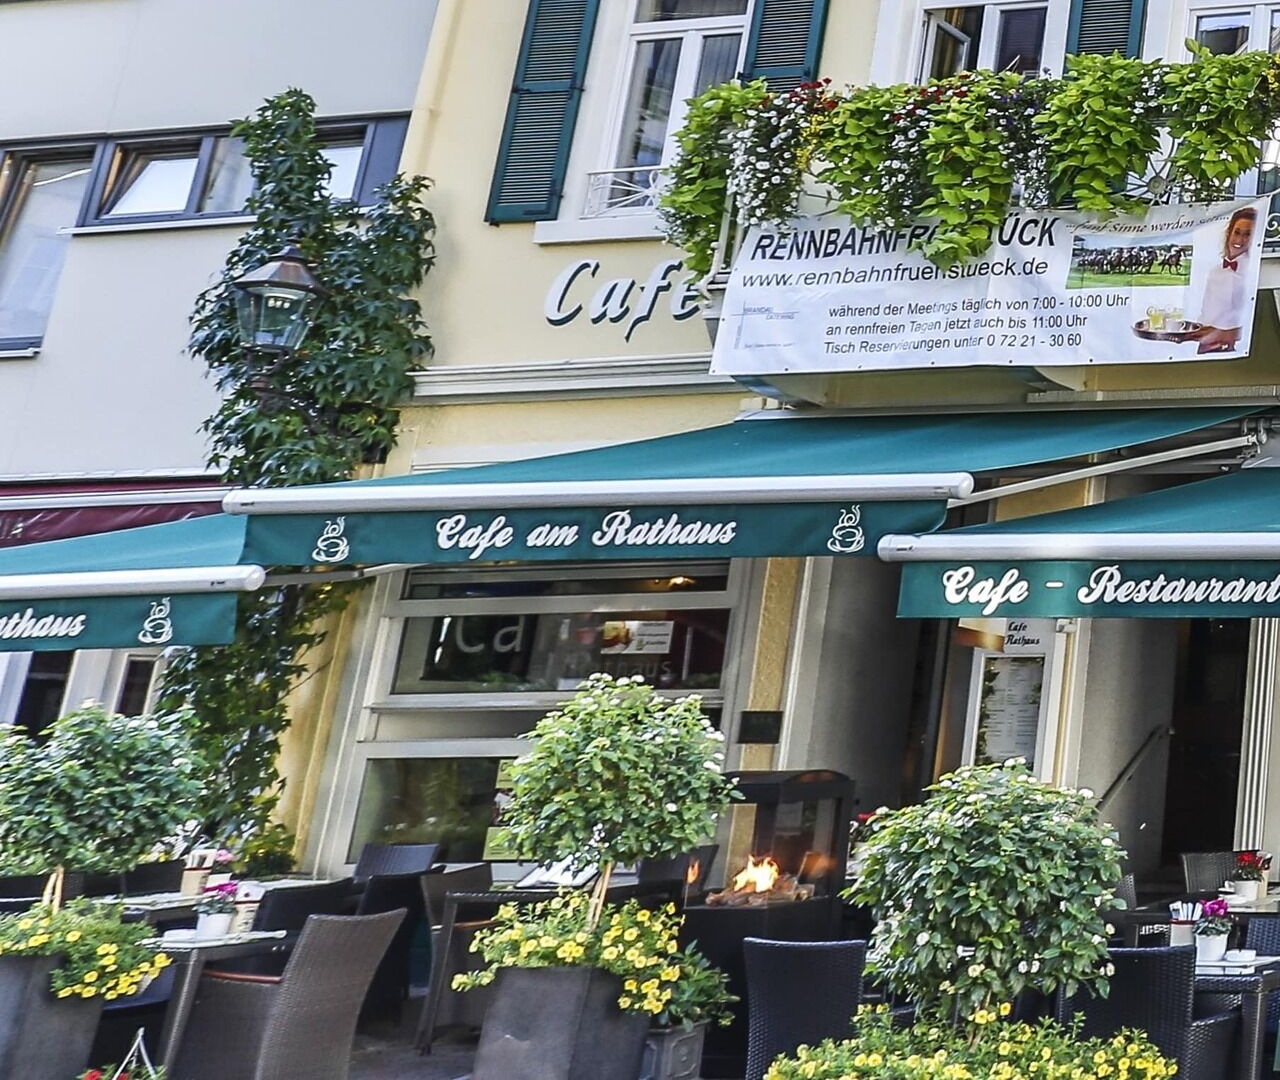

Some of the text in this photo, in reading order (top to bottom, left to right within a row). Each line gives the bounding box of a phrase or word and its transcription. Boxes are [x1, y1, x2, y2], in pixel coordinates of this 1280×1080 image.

[1109, 222, 1144, 232] Sinne
[1151, 215, 1194, 231] werden
[750, 213, 1060, 260] RENNBAHNFRÜCK
[544, 260, 700, 343] Cafe
[829, 303, 880, 318] während
[884, 303, 900, 316] der
[907, 300, 957, 317] Meetings
[962, 297, 1001, 314] täglich
[1006, 301, 1029, 311] von
[1033, 297, 1056, 310] 7:00
[1070, 295, 1102, 309] 10:00
[1107, 294, 1129, 307] Uhr
[826, 314, 1087, 336] an rennfreien Tagen jetzt auch bis 11:00 Uhr
[824, 340, 855, 354] Tisch
[860, 335, 950, 353] Reservierungen
[954, 335, 984, 348] unter
[986, 334, 995, 347] 0
[1000, 334, 1016, 347] 72
[1020, 334, 1036, 347] 21
[1052, 333, 1064, 346] 30
[1067, 332, 1081, 346] 60
[435, 510, 737, 559] Cafe am Rathaus
[942, 565, 1030, 616] Cafe
[1008, 621, 1028, 634] Cafe
[1005, 634, 1040, 647] Rathaus
